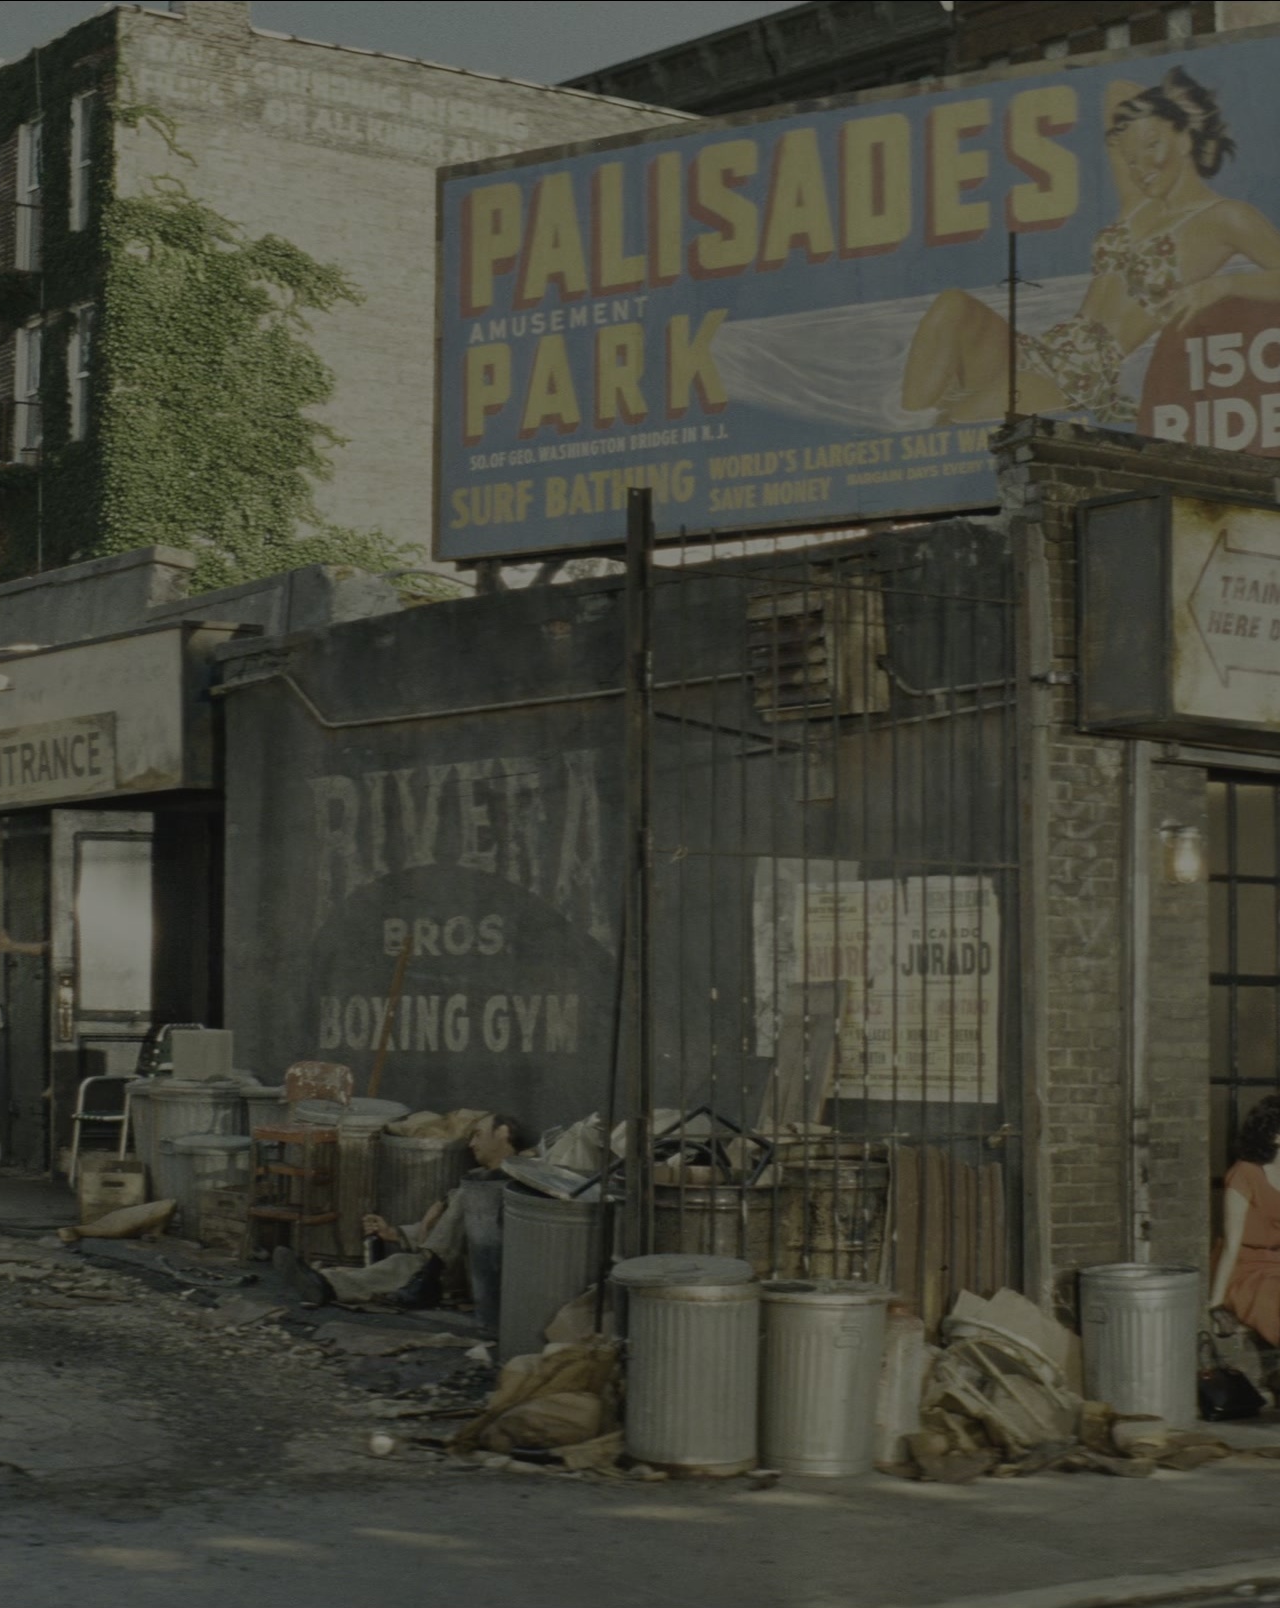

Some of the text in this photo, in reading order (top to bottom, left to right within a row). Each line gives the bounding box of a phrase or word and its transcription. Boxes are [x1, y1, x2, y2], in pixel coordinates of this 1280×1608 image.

[461, 84, 1080, 320] PALISADES
[470, 295, 647, 344] AMUSEMENT
[464, 308, 732, 446] PARK
[538, 437, 626, 461] WASHINGTON
[630, 428, 679, 451] BRIDGE
[681, 426, 697, 443] IN
[709, 449, 796, 481] WORLD'S
[804, 437, 894, 471] LARGEST
[901, 429, 952, 459] SALT
[449, 459, 696, 529] SURF BATHING
[709, 486, 756, 513] SAVE
[762, 477, 832, 506] MONEY
[1208, 609, 1262, 636] HERE
[306, 748, 617, 957] RIVERA
[912, 927, 981, 939] RCARDO
[901, 942, 992, 976] JURADO
[320, 993, 579, 1053] BOXING GYM
